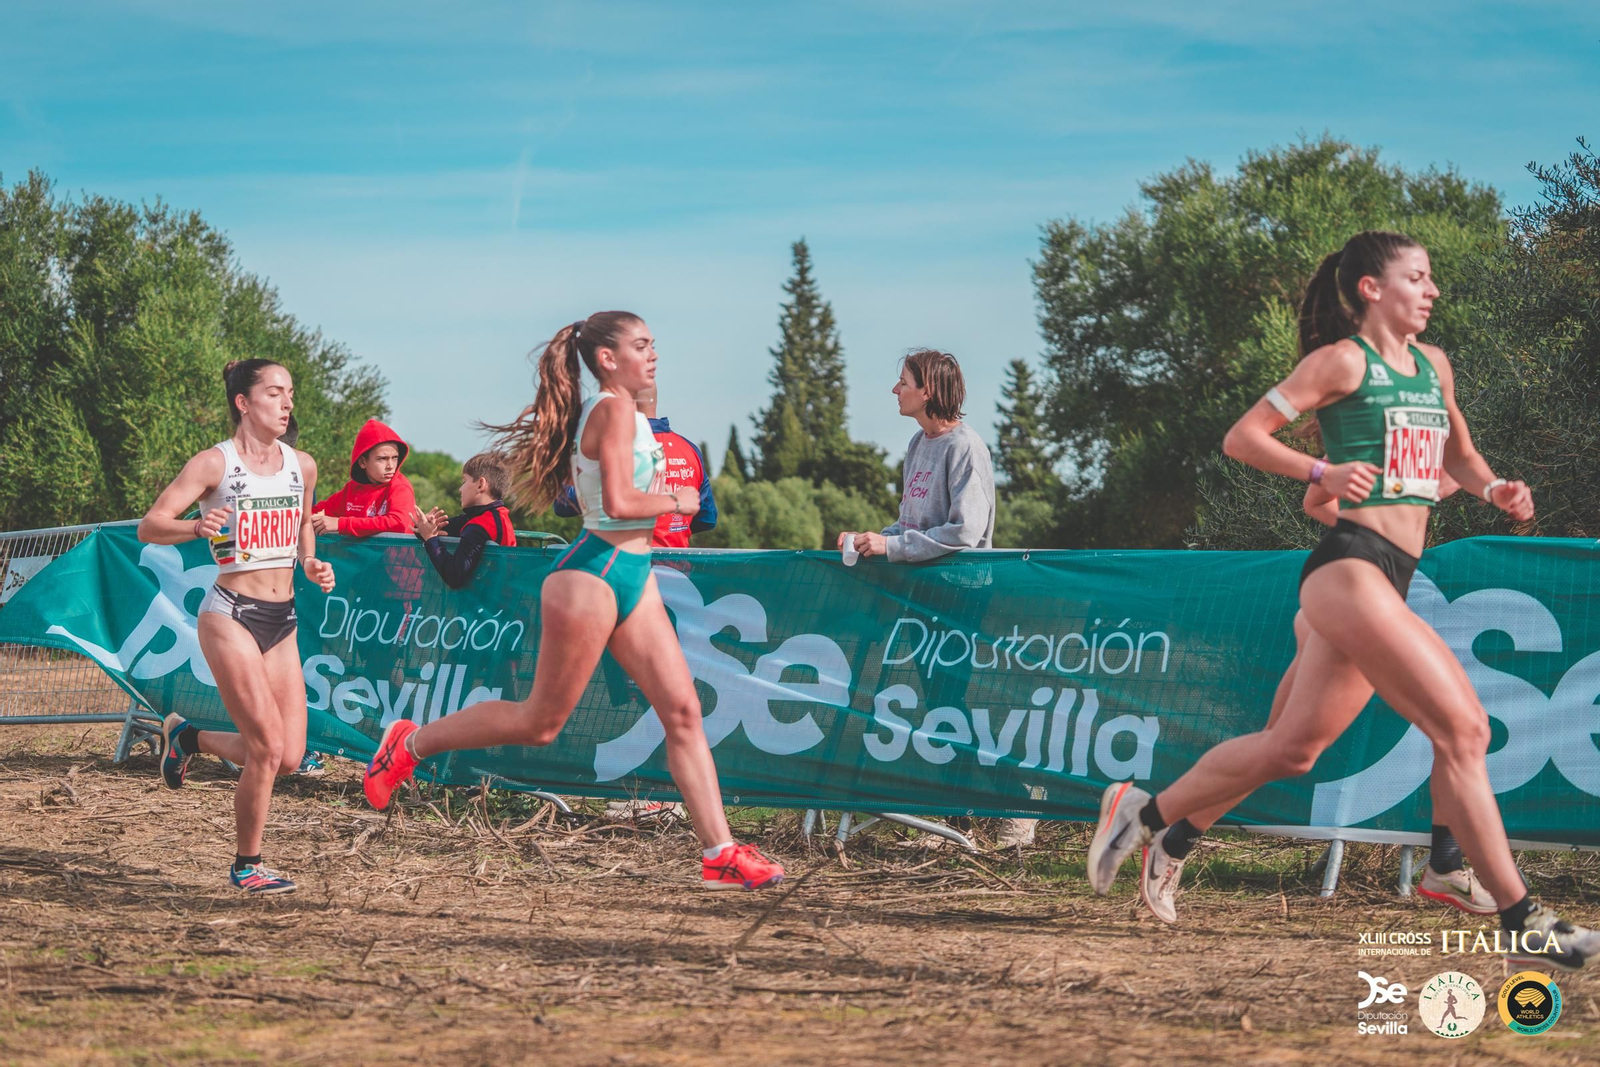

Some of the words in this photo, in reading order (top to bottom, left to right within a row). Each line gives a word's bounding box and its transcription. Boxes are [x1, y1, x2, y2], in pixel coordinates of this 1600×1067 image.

[238, 508, 300, 550] GARRIDO
[319, 595, 525, 652] Diputación
[882, 616, 1171, 678] Diputación
[863, 683, 1161, 780] Sevilla
